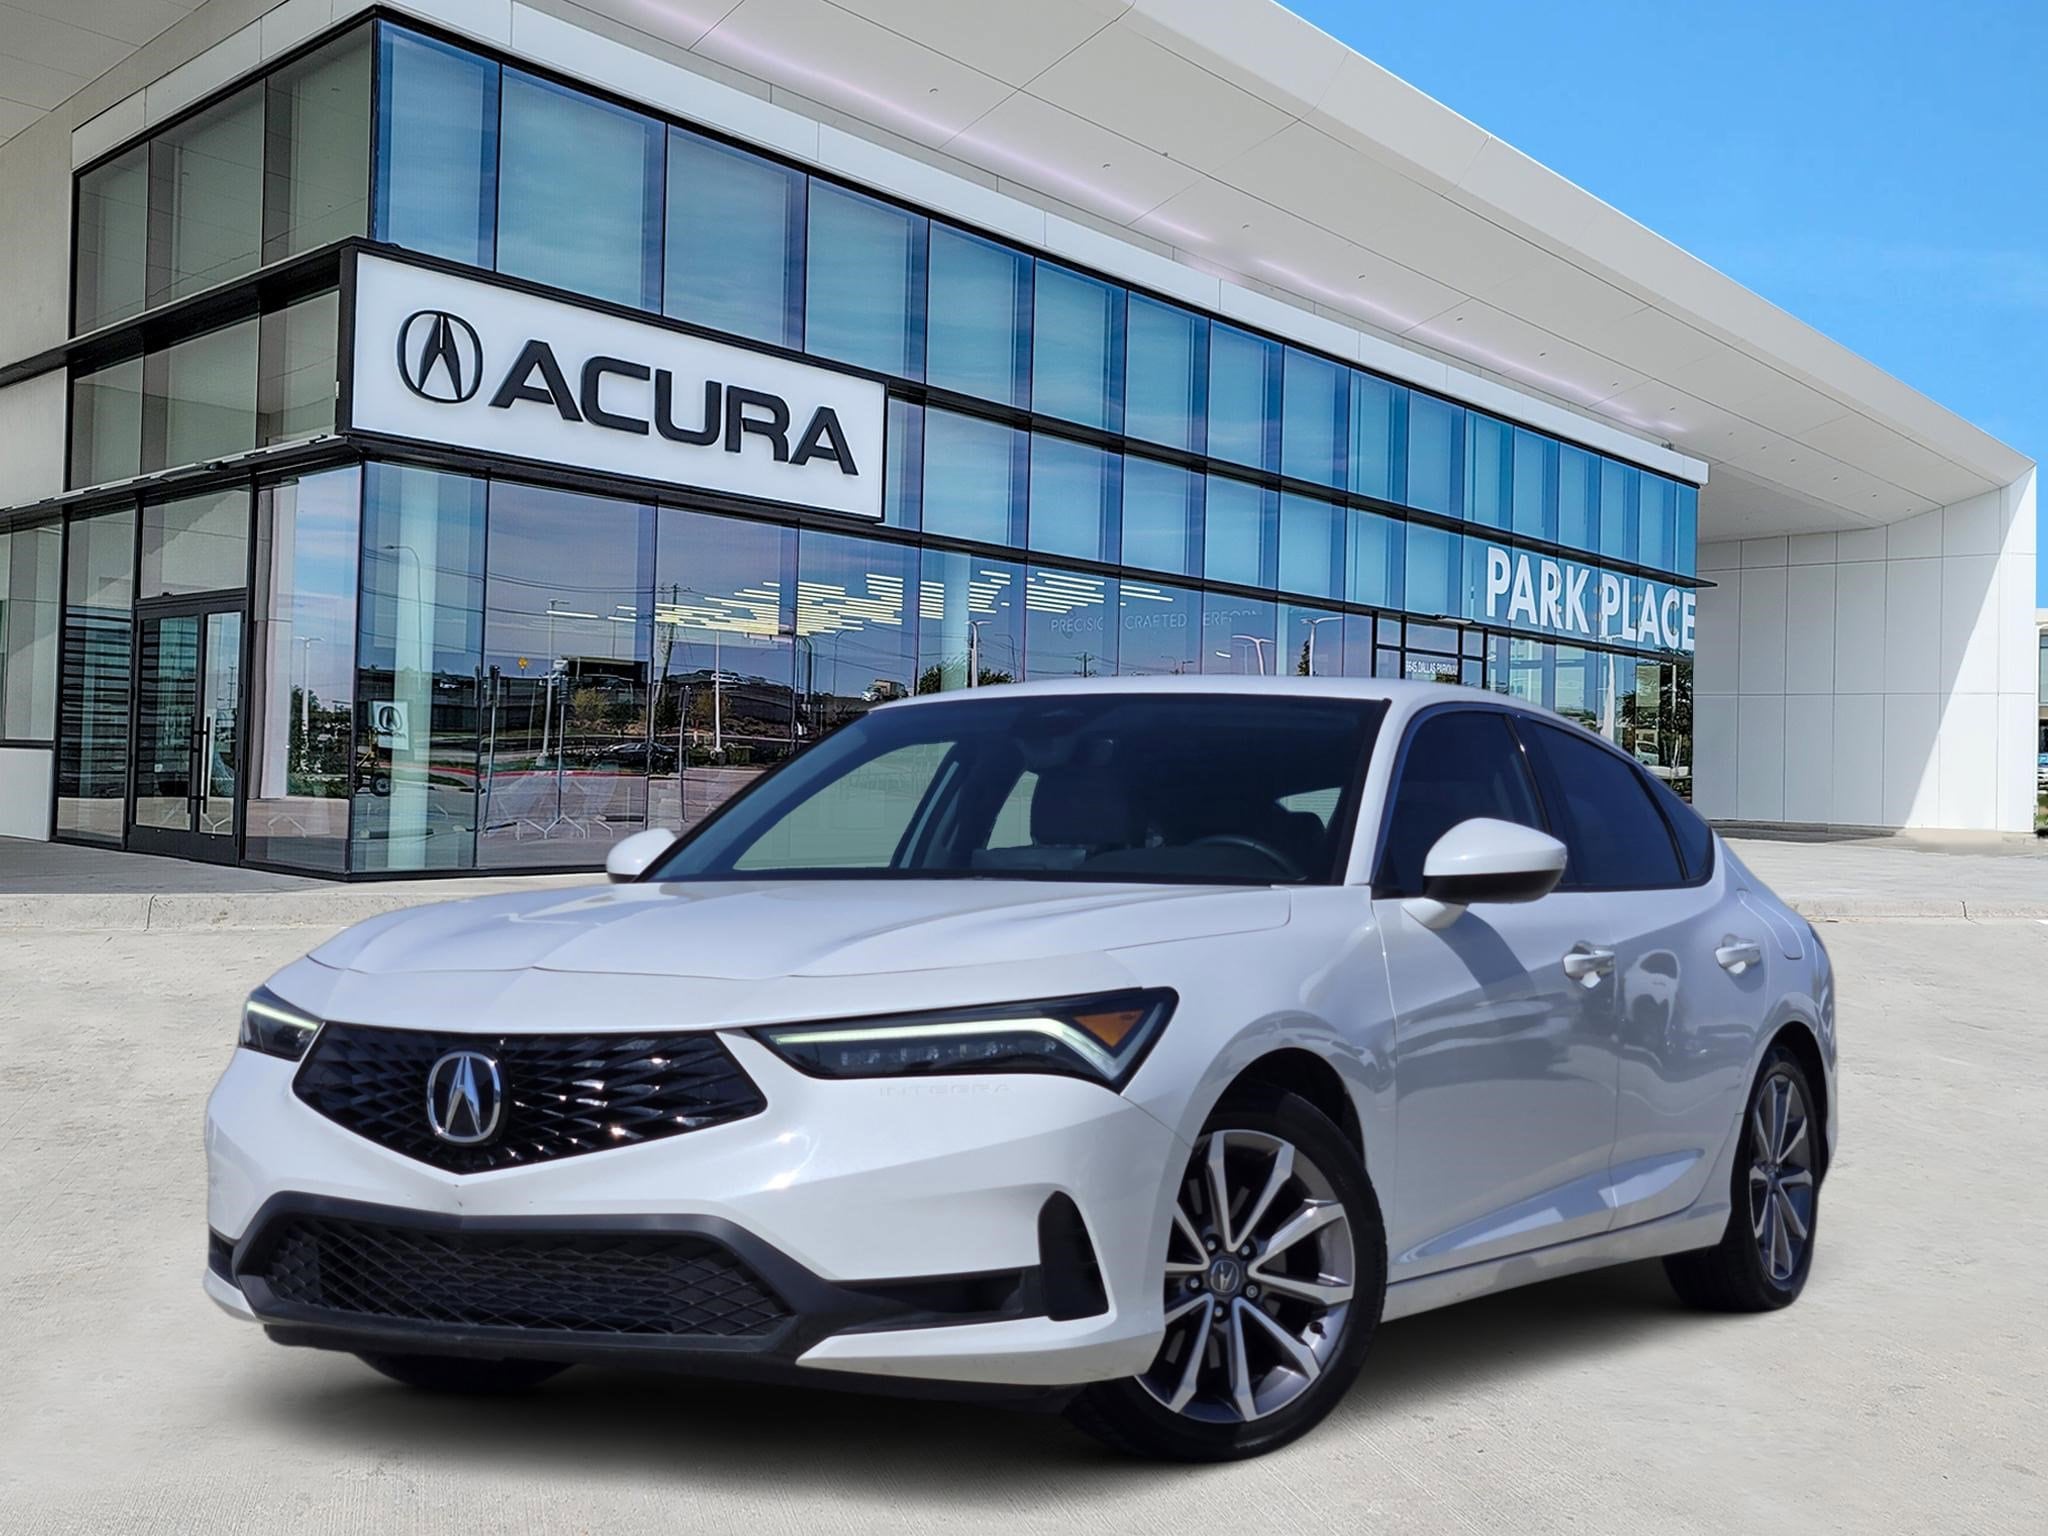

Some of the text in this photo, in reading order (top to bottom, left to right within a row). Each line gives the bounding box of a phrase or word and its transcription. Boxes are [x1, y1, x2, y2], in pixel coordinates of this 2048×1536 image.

[489, 340, 858, 476] ACURA
[1124, 613, 1187, 630] CRAFTED
[1486, 546, 1697, 650] PARK PLACE
[880, 1083, 1014, 1097] INTEGRA
